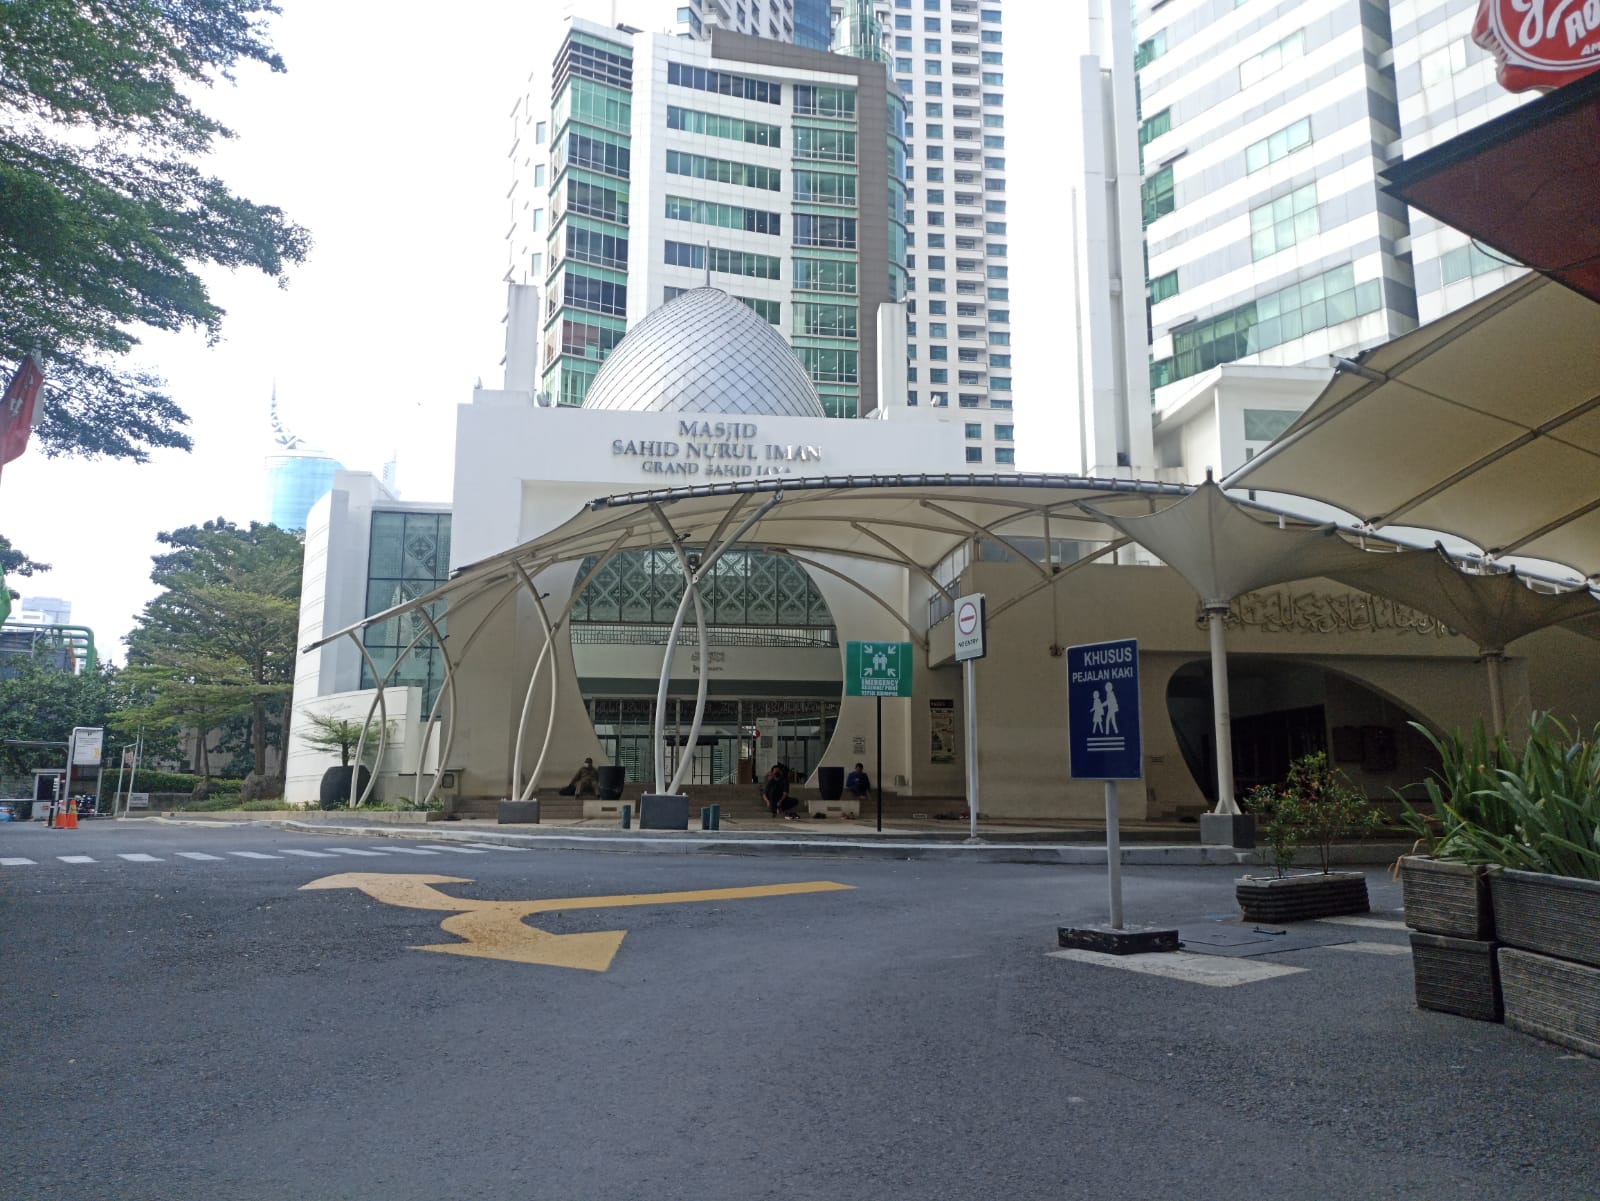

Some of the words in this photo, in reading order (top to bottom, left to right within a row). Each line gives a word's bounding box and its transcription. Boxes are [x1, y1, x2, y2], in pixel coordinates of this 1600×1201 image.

[679, 420, 758, 441] MASJID
[612, 439, 679, 457] SAHID
[686, 442, 758, 460] NURUL
[765, 444, 822, 461] IMAN
[642, 460, 699, 475] GRAND
[957, 640, 964, 648] NO
[964, 637, 979, 647] ENTRY
[1084, 647, 1133, 667] KHUSUS
[1072, 669, 1110, 683] PEJALAN
[1111, 666, 1133, 679] KAKI
